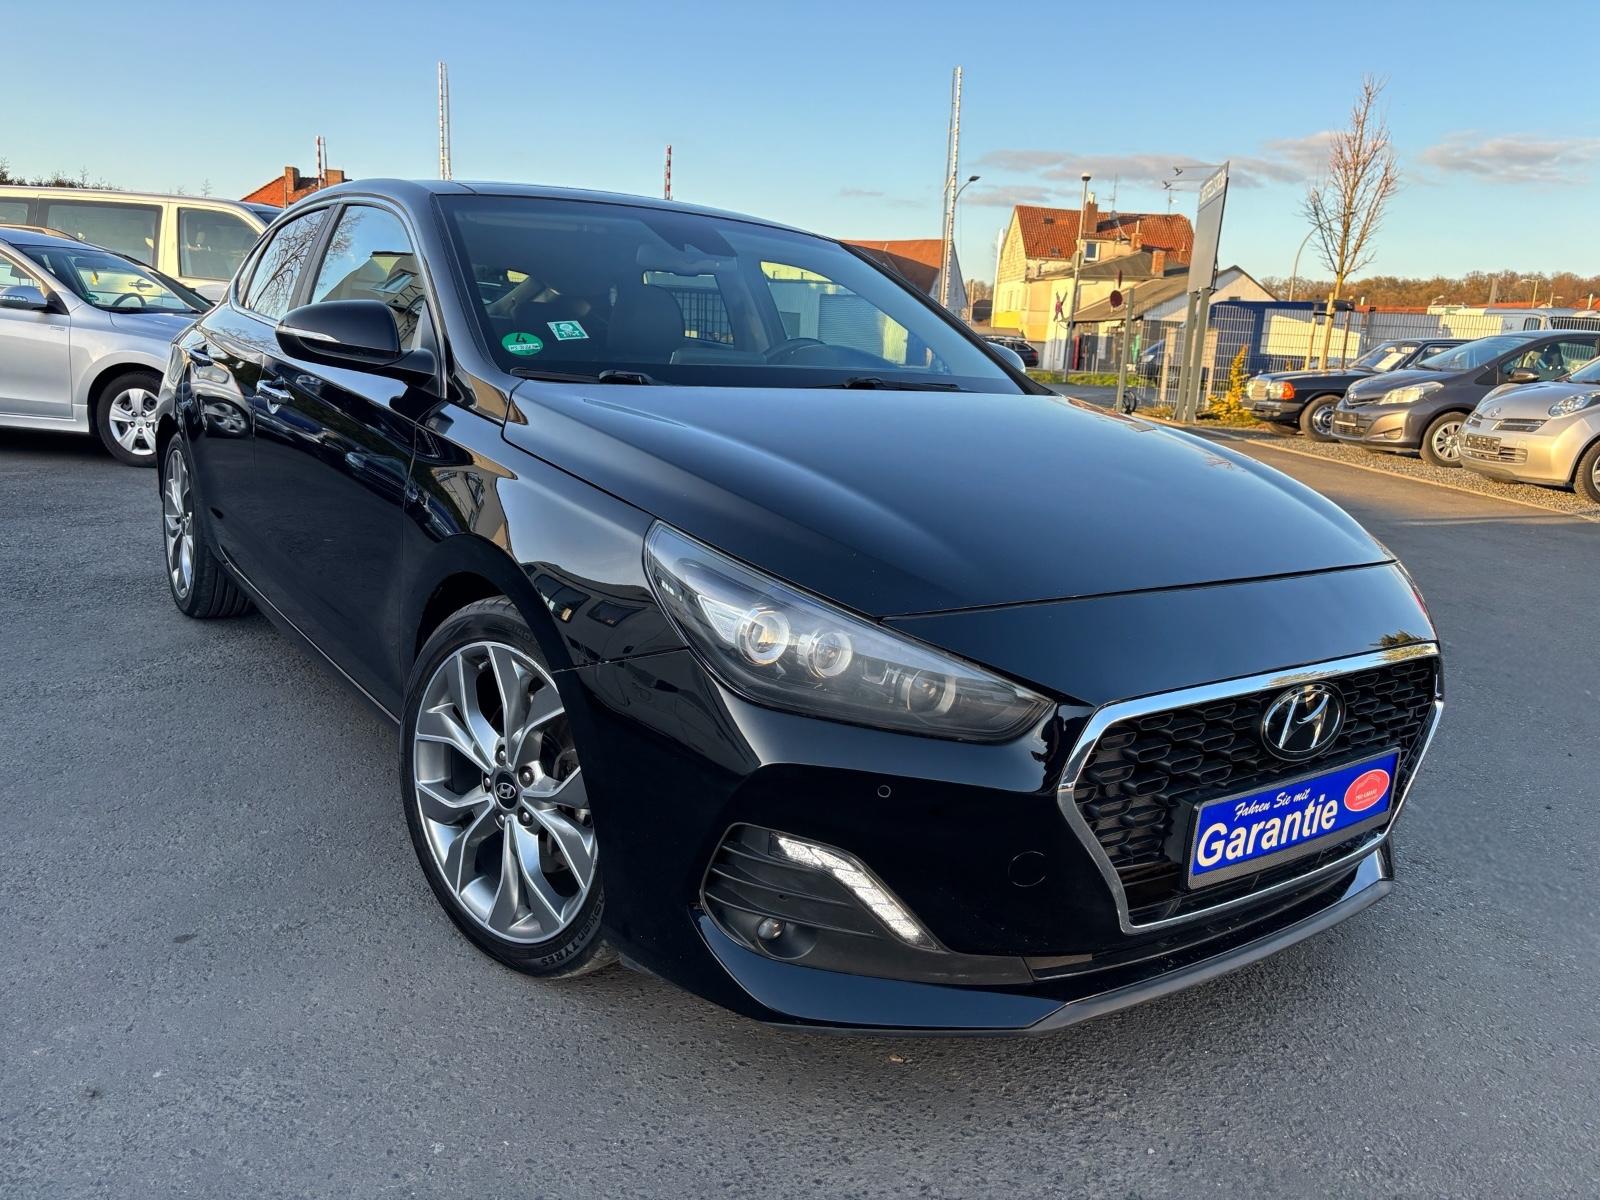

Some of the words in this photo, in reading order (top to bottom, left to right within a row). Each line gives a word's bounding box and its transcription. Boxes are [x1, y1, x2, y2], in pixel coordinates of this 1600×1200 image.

[1234, 800, 1271, 822] Fahren
[1273, 791, 1292, 808] Sie
[1293, 787, 1311, 803] mit
[1197, 794, 1338, 867] Garantie
[541, 941, 580, 967] TYRES
